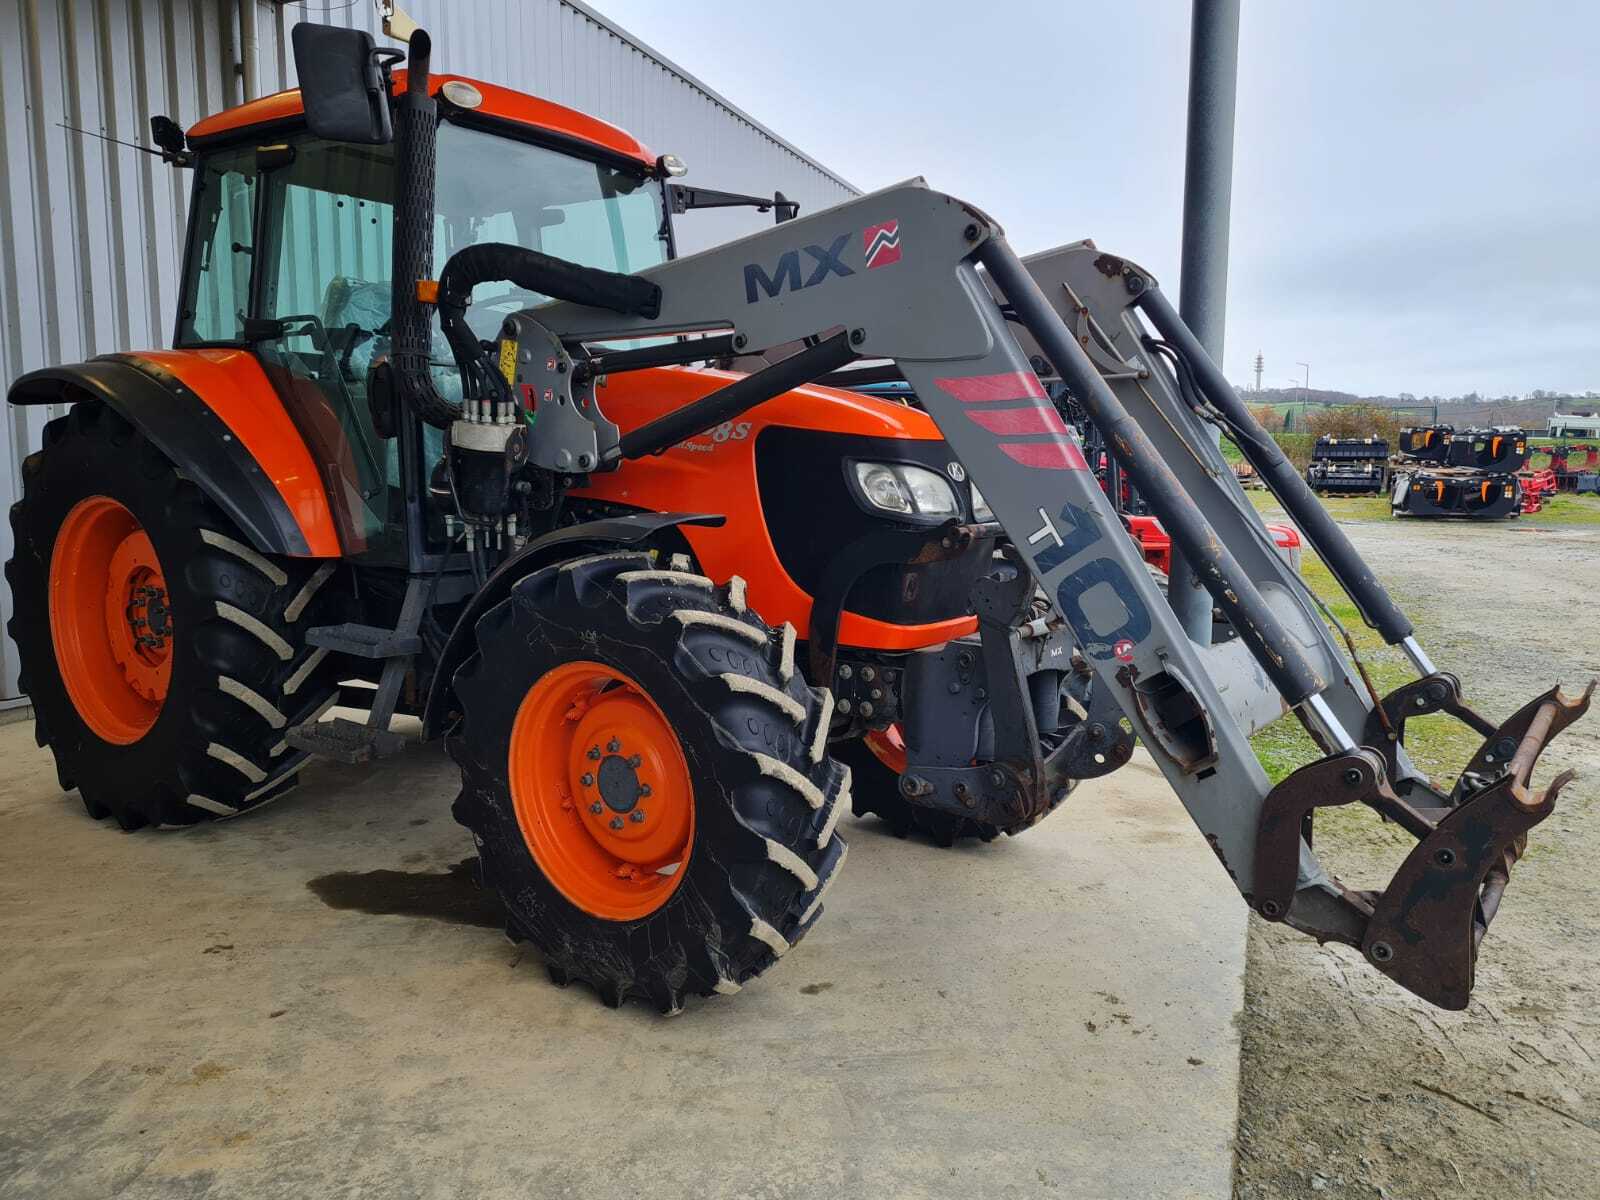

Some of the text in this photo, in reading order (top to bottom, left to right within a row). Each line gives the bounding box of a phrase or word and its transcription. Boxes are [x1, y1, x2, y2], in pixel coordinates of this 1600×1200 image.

[744, 232, 856, 304] MX
[702, 421, 752, 442] 8S
[1050, 646, 1063, 657] MX
